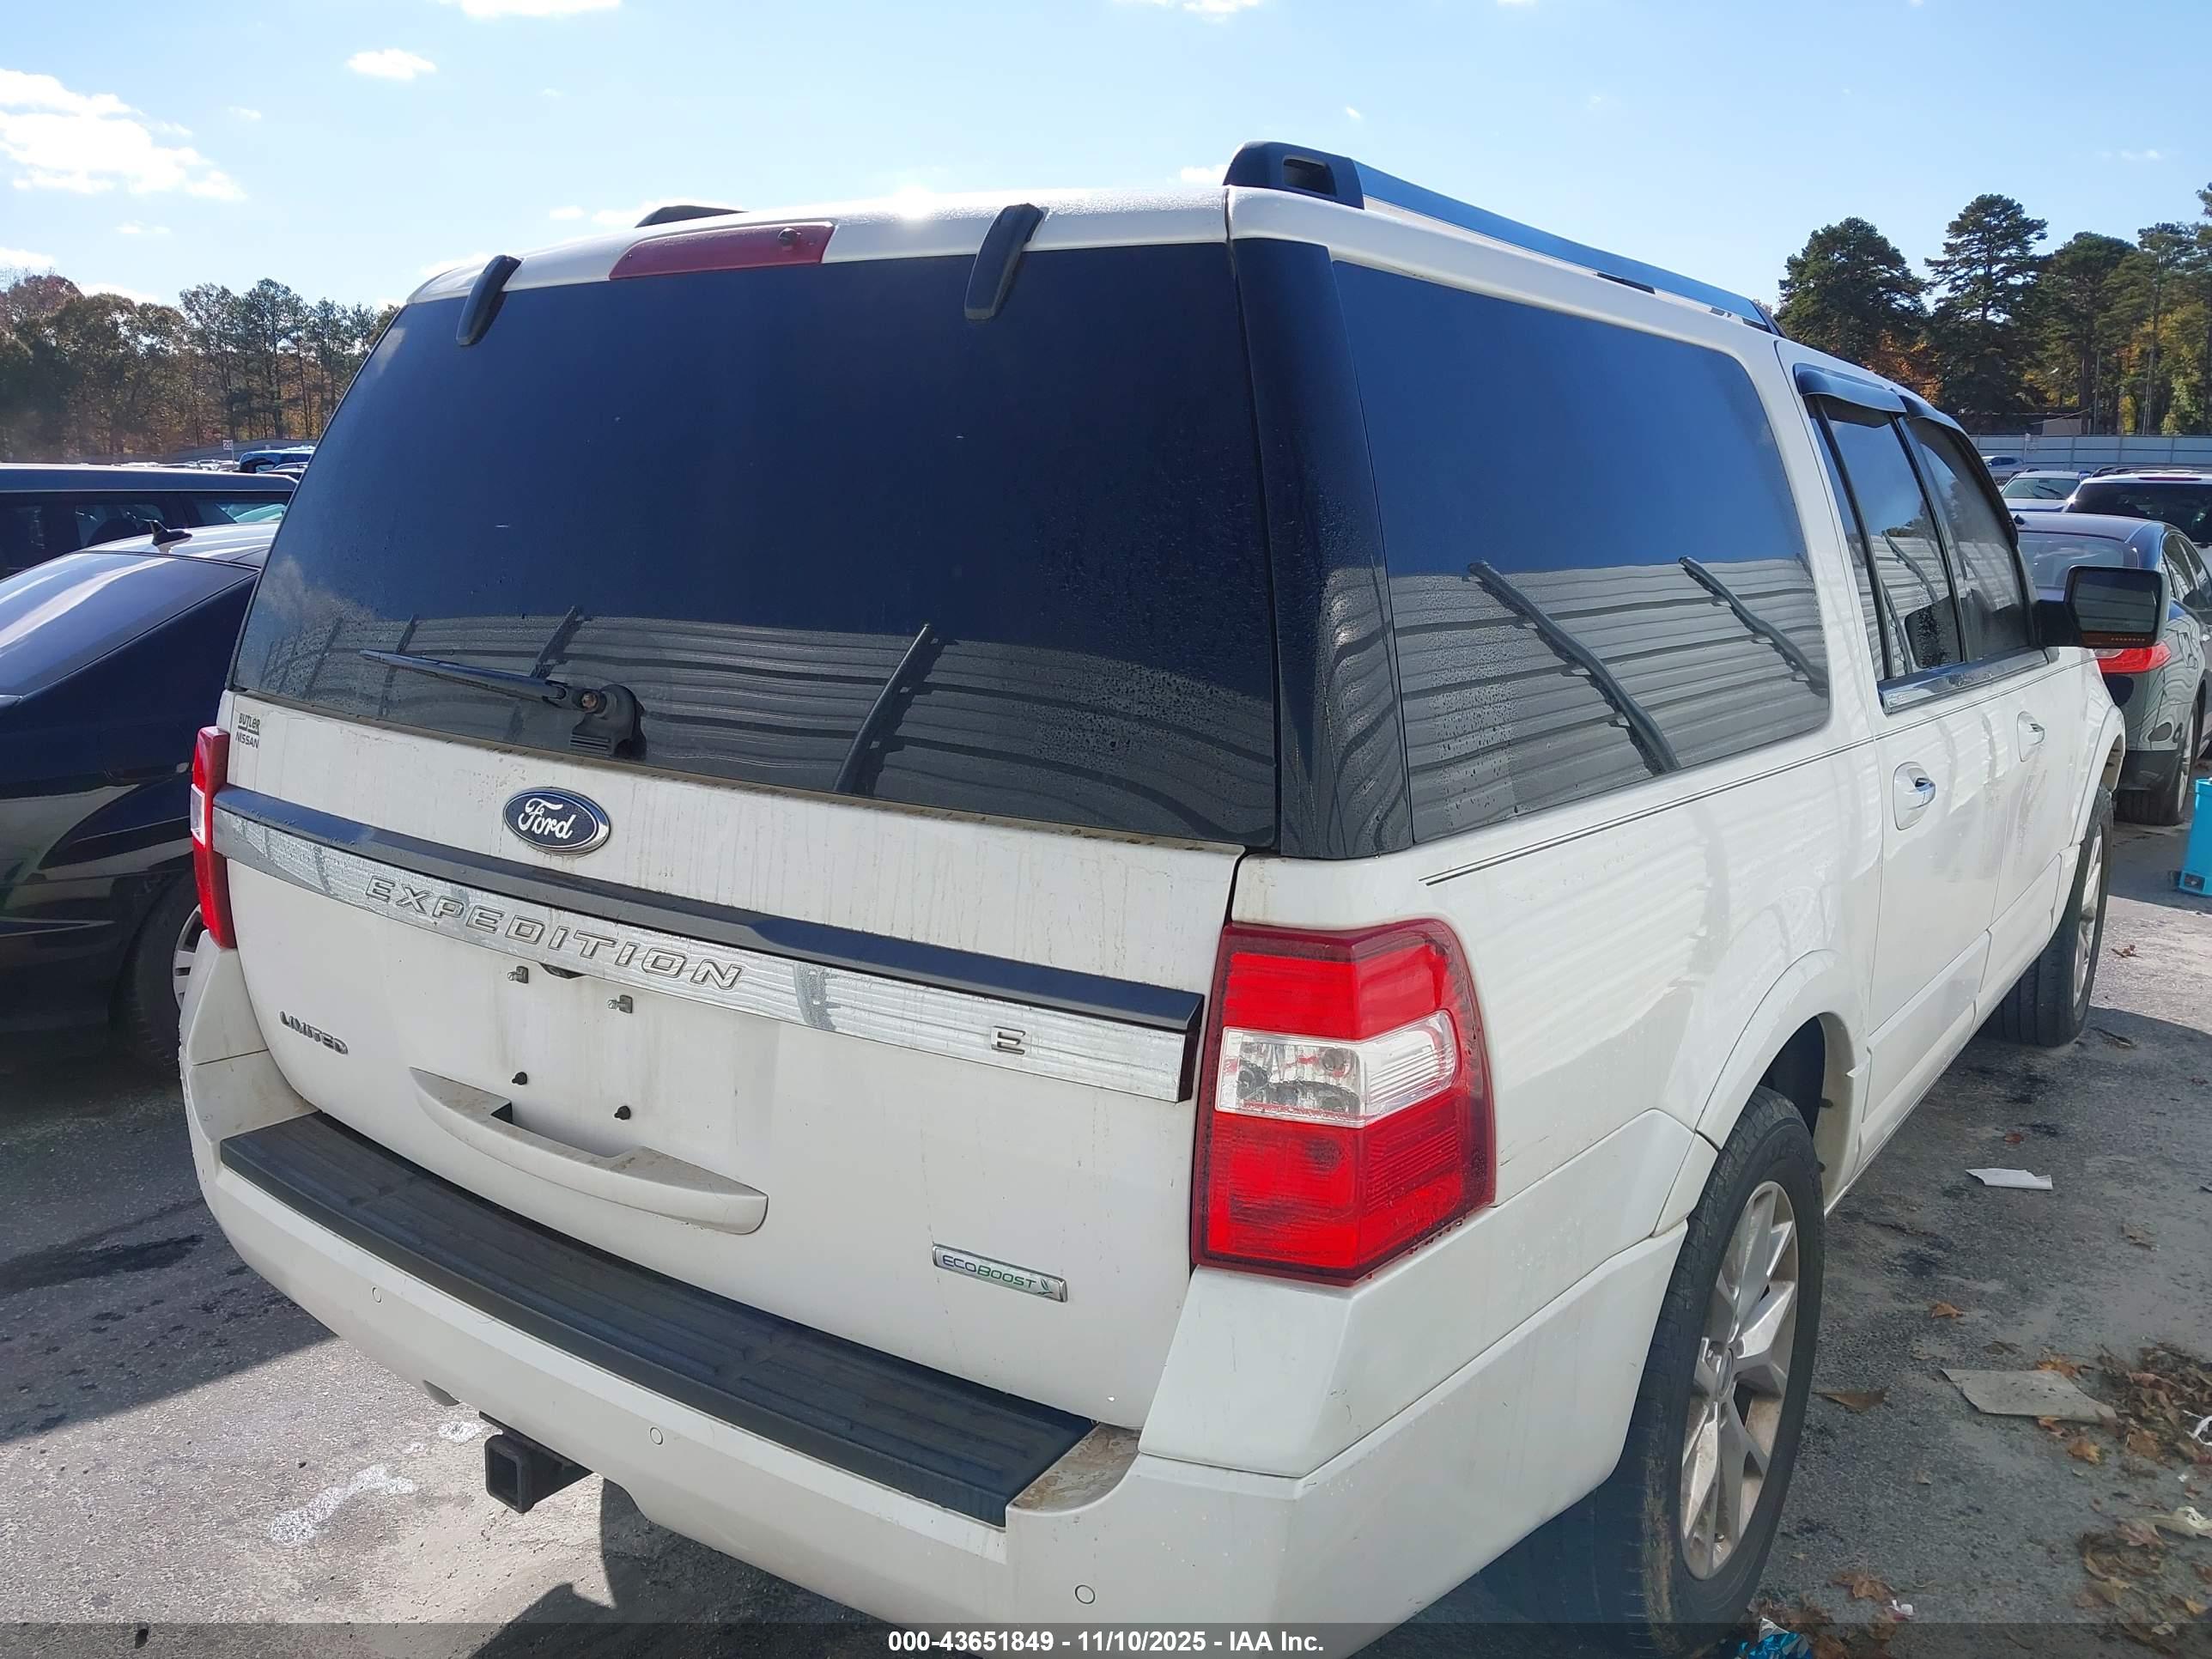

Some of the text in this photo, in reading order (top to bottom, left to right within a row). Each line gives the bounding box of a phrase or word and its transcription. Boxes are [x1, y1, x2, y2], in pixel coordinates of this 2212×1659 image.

[235, 731, 259, 749] NISSAN
[518, 798, 576, 839] Ford
[365, 875, 742, 990] EXPEDITION
[280, 1011, 348, 1054] LIMITED
